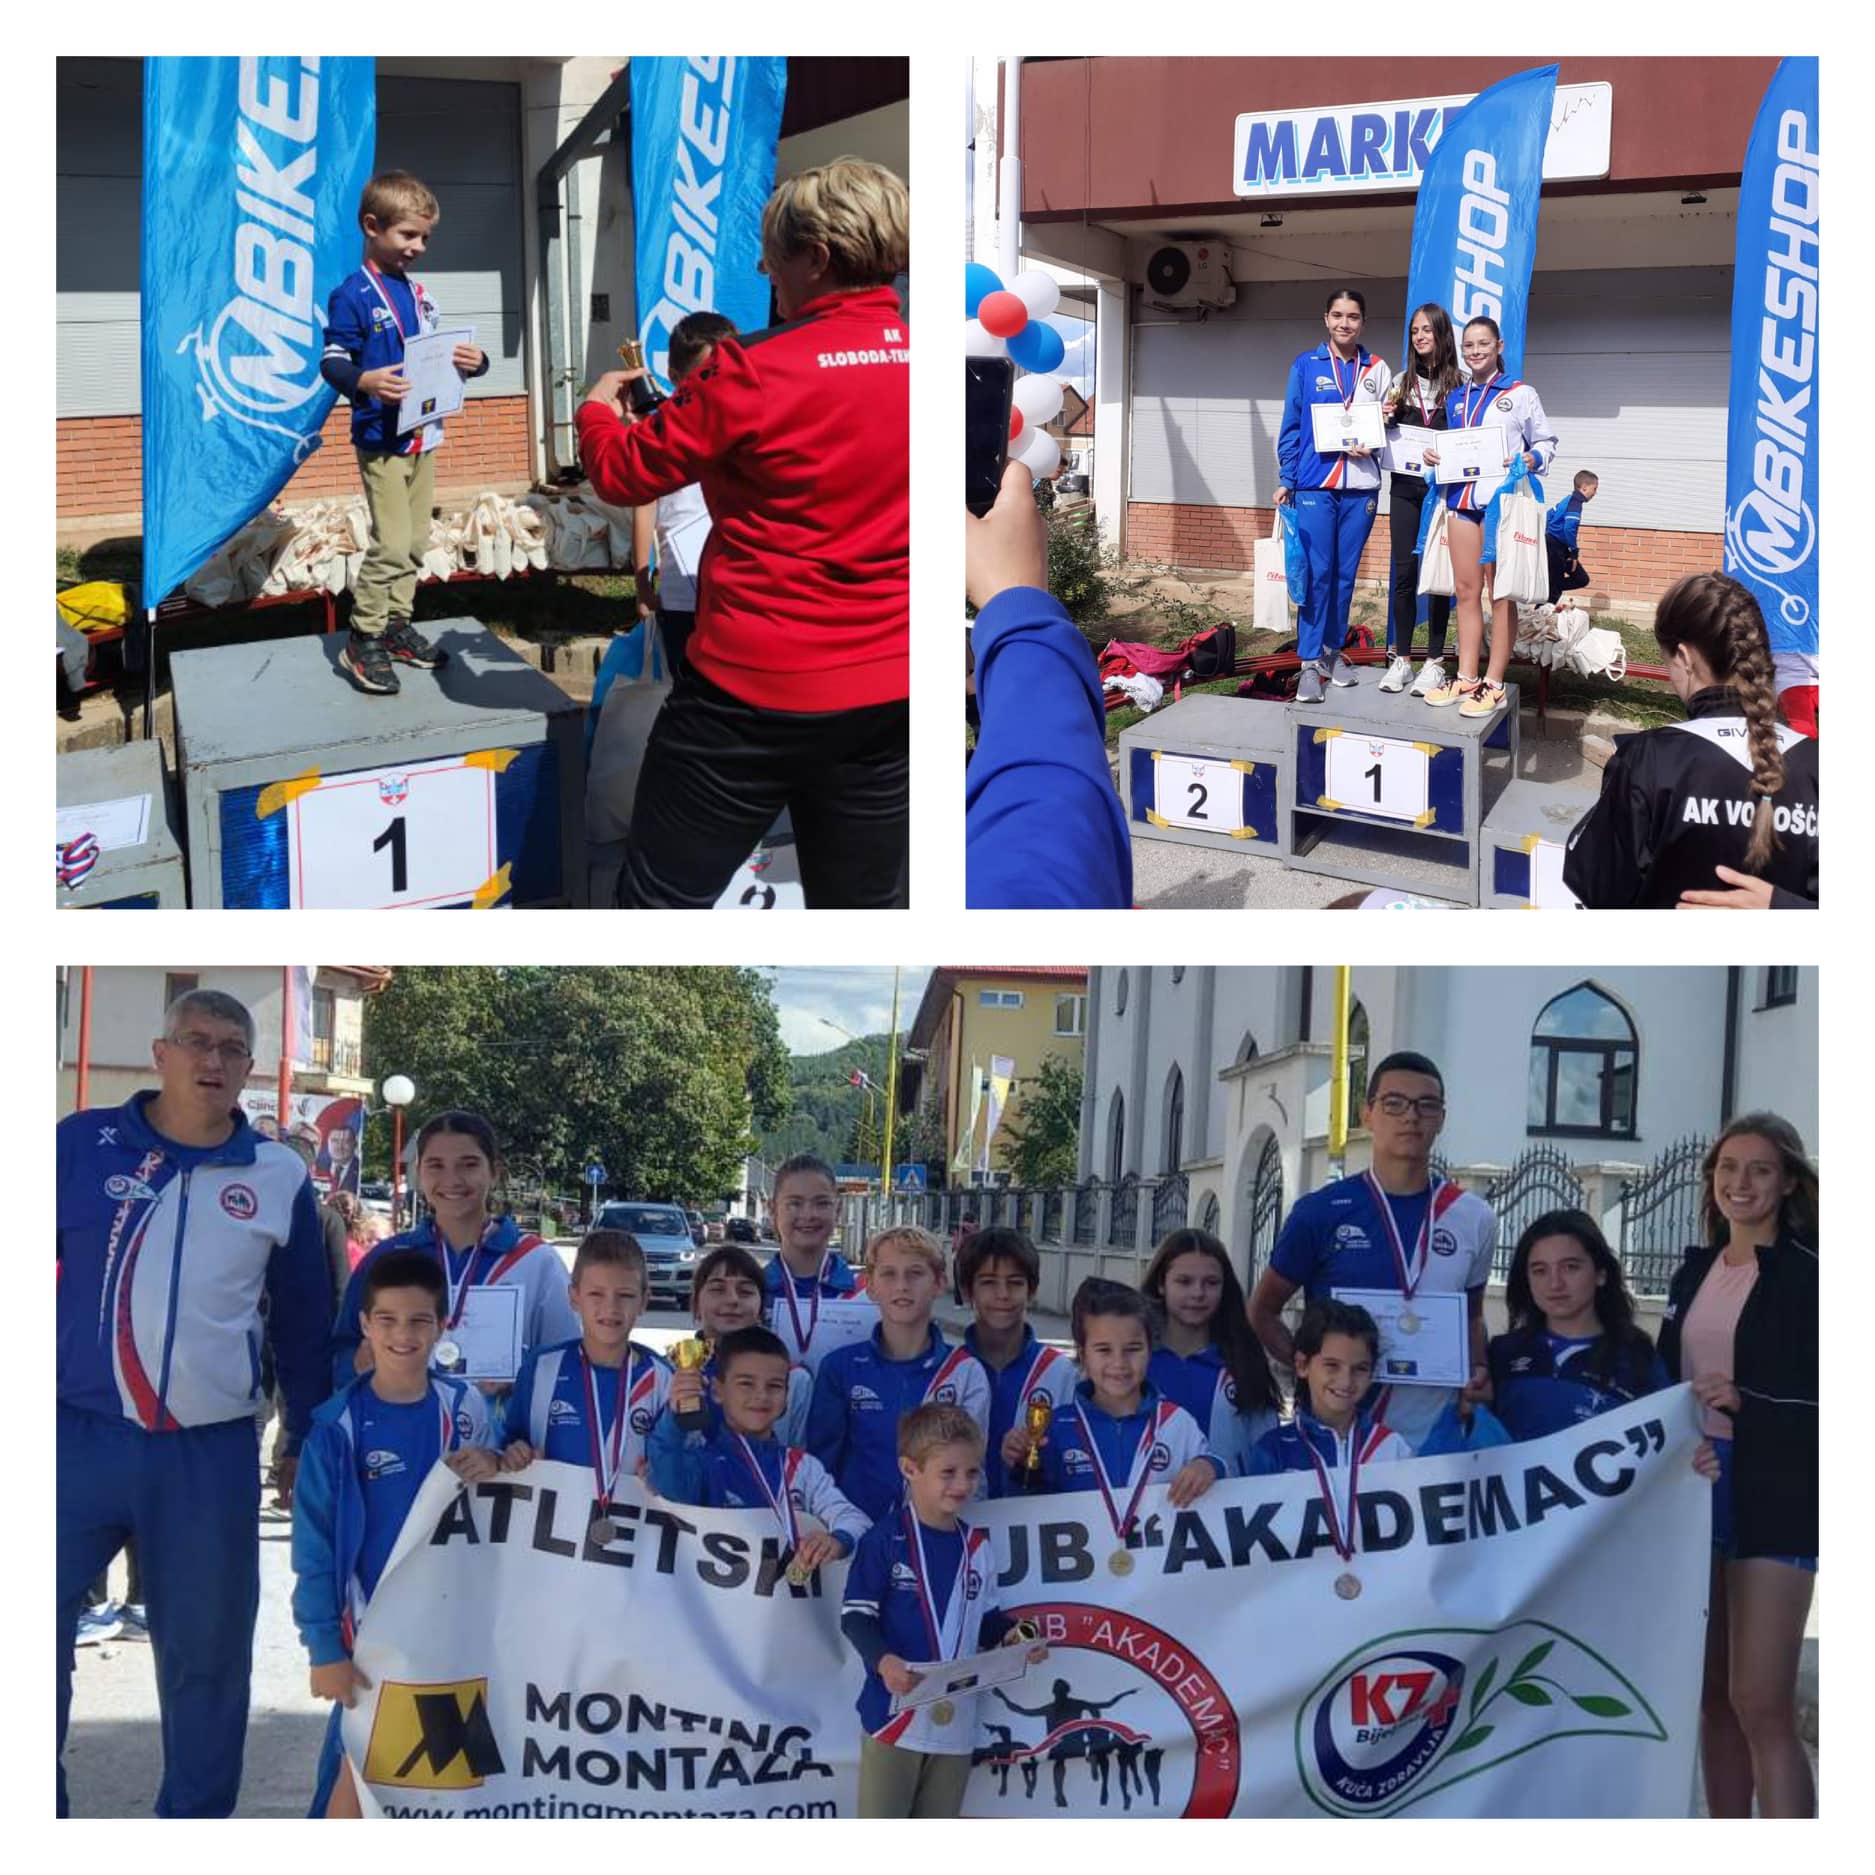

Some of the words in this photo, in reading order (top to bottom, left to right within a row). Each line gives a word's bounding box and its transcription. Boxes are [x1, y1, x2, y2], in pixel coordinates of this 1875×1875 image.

[1243, 106, 1466, 187] MARK
[230, 56, 321, 401] MBIKE
[883, 328, 903, 343] AK
[1745, 109, 1819, 567] MBIKESHOP
[1186, 782, 1209, 820] 2
[1363, 762, 1383, 804] 1
[1682, 796, 1719, 825] AK
[1725, 799, 1819, 838] VOOŠĆ
[373, 815, 408, 893] 1
